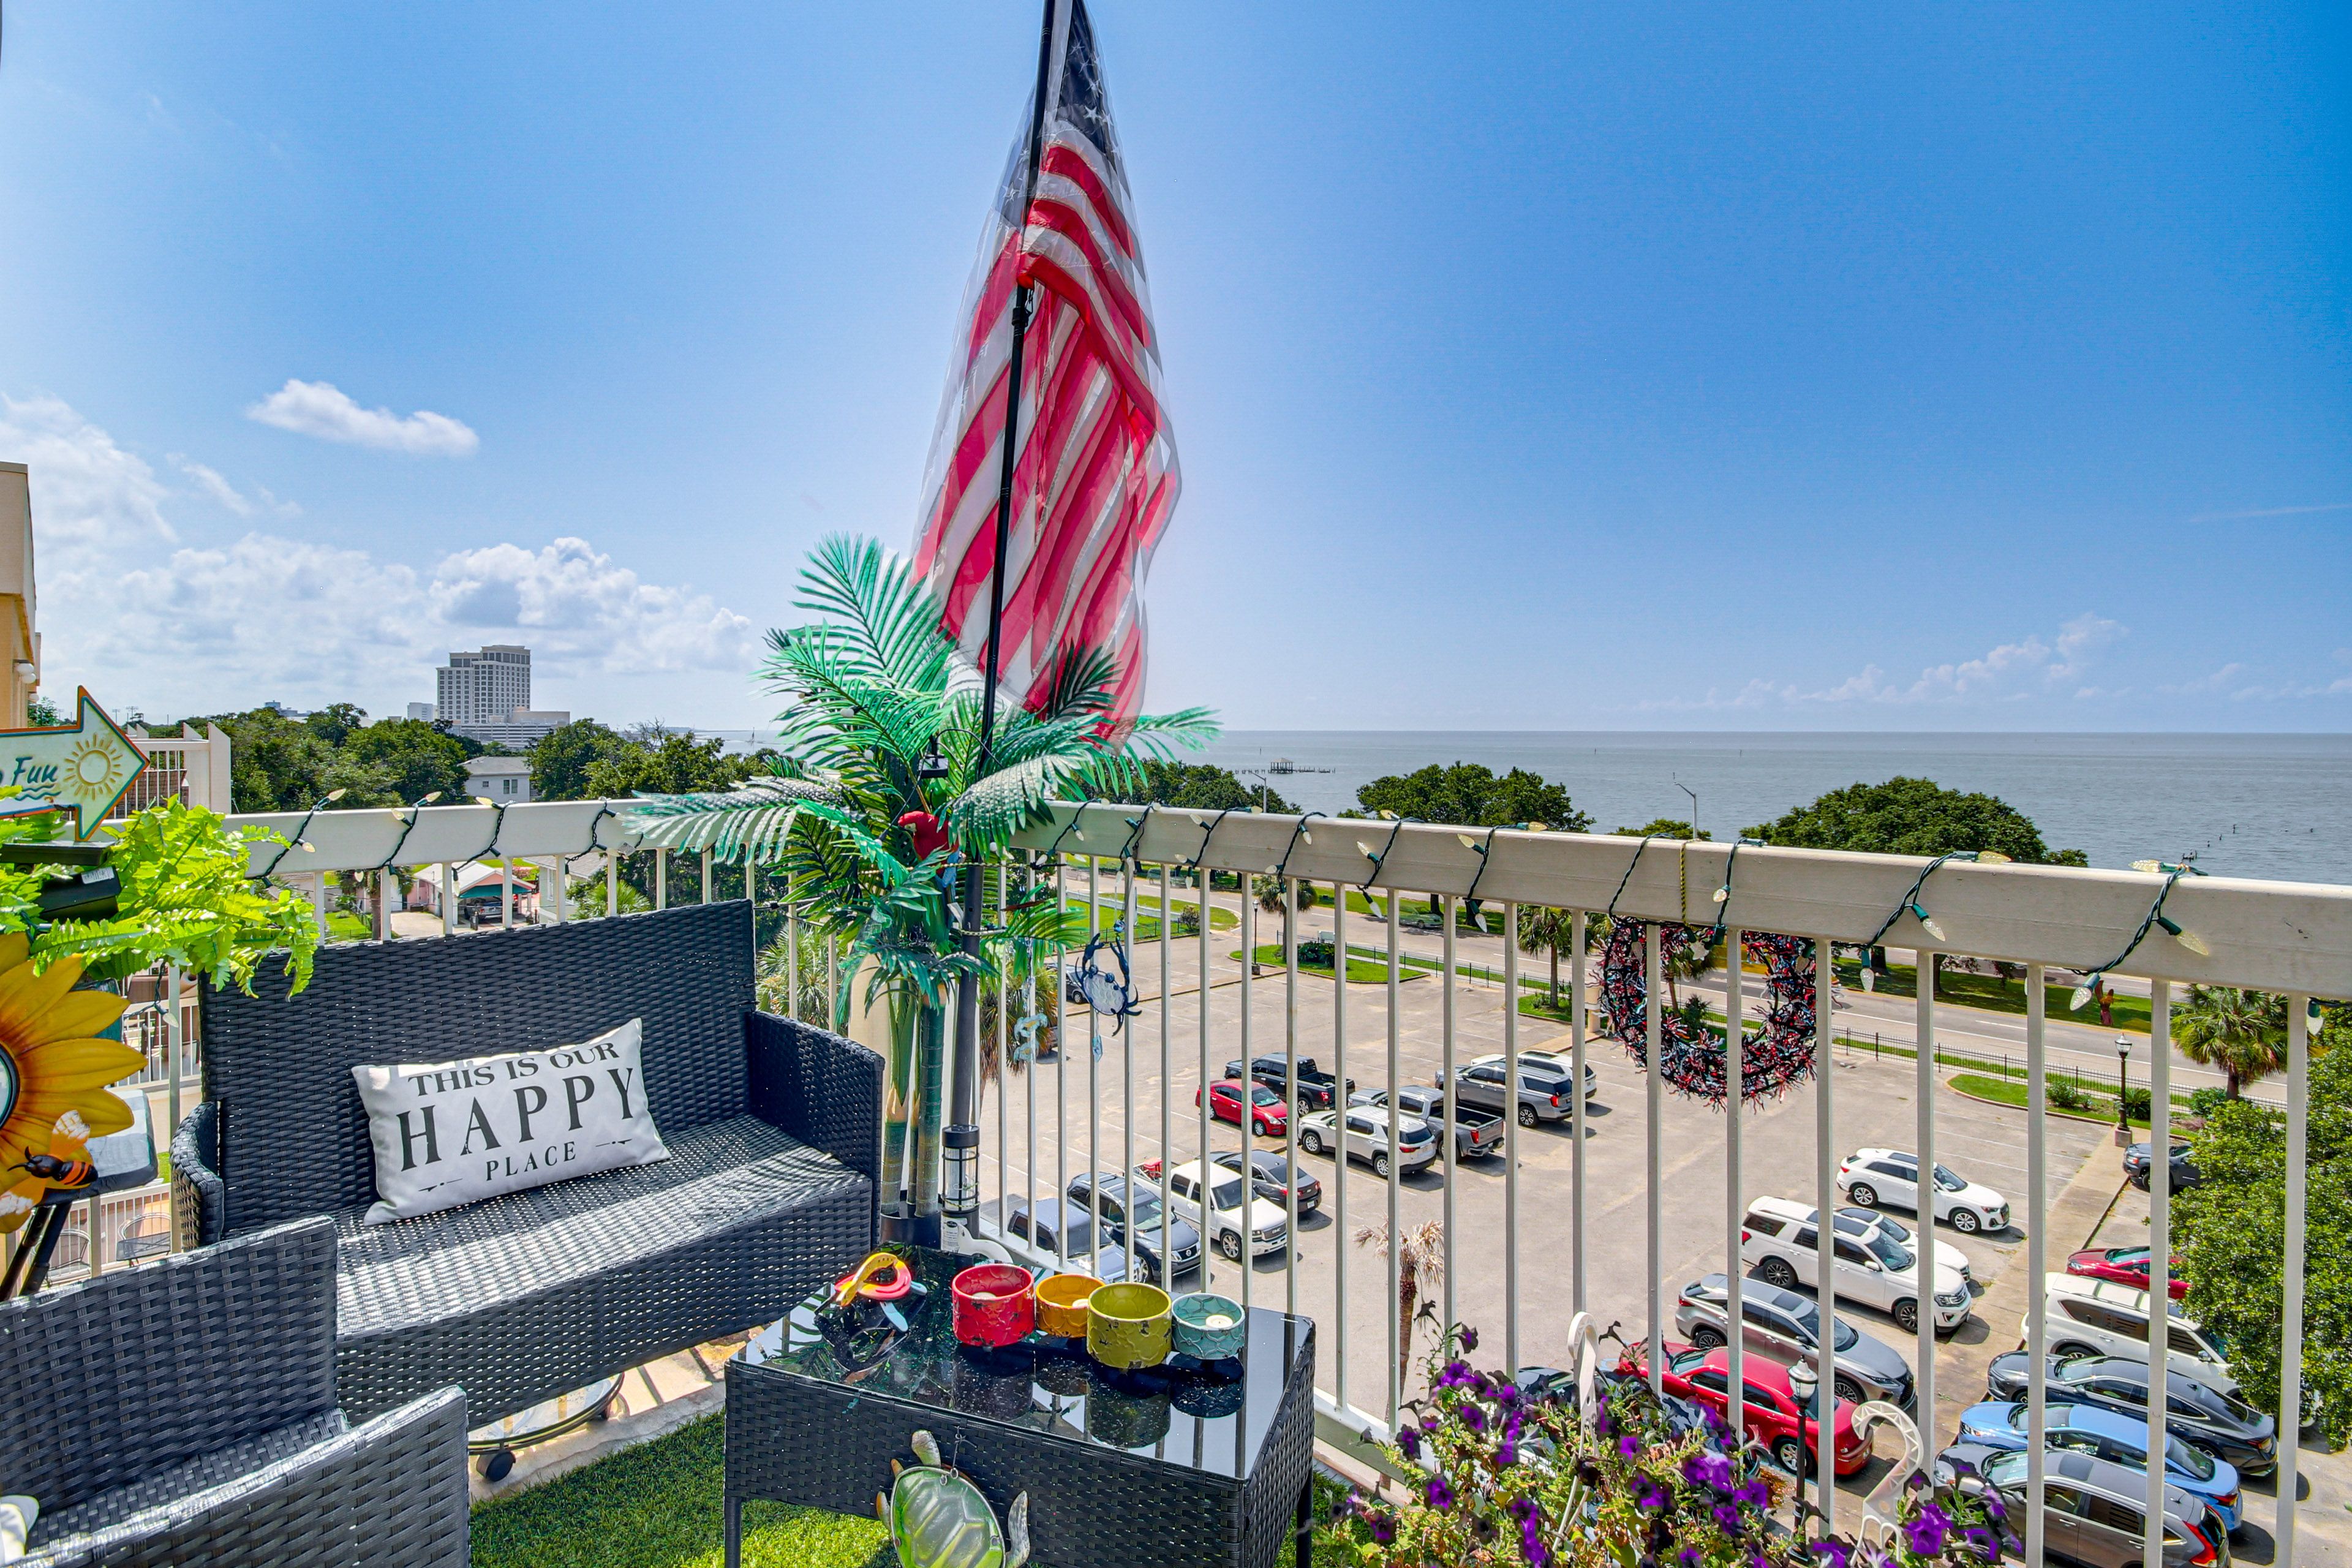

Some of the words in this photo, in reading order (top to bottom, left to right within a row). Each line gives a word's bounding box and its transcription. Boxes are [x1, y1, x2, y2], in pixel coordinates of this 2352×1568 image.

[10, 756, 58, 787] Fun
[408, 1066, 495, 1096] THIS
[505, 1057, 539, 1080] IS
[549, 1042, 620, 1069] OUR
[396, 1067, 633, 1172] HAPPY
[486, 1141, 576, 1181] PLACE
